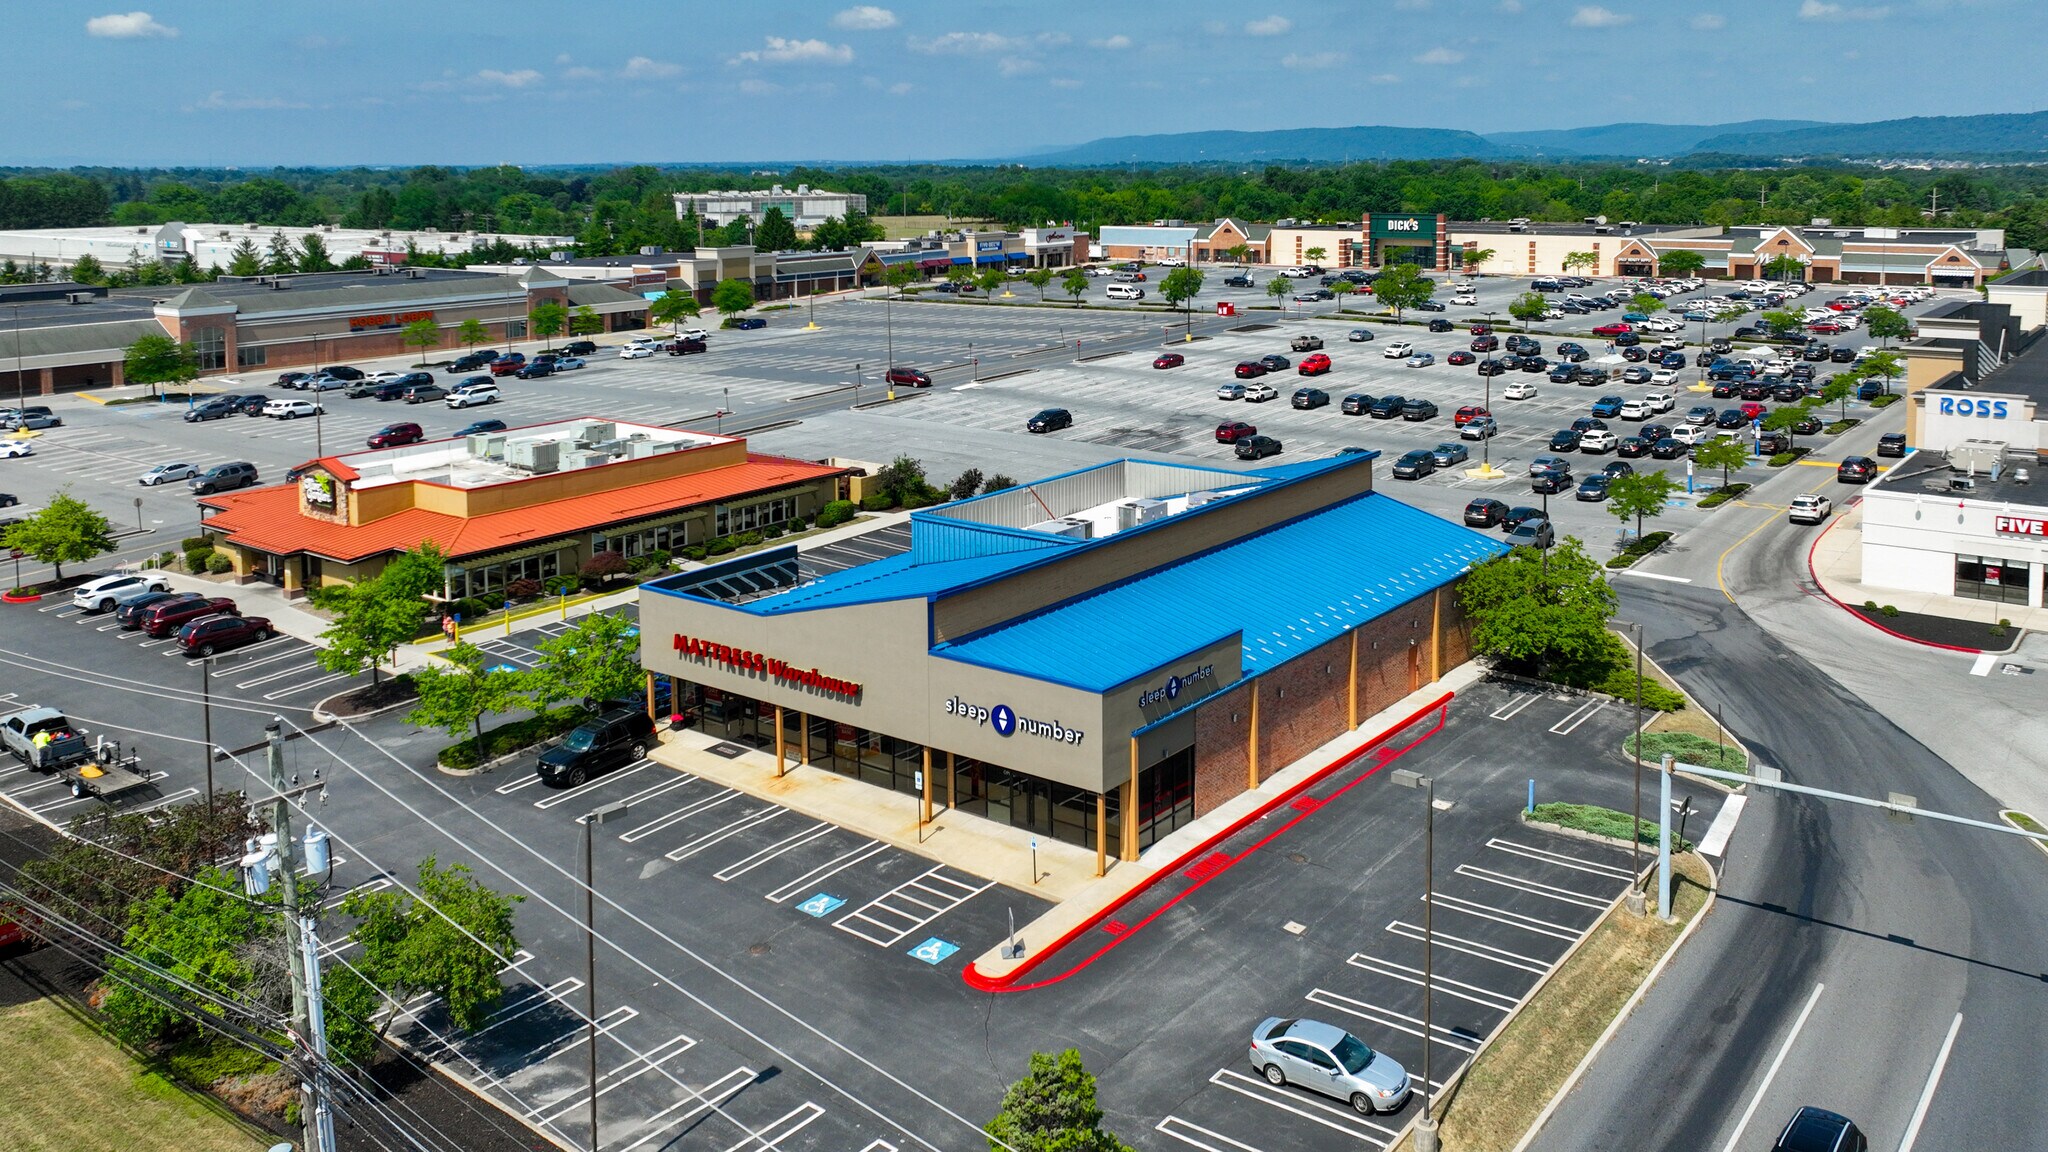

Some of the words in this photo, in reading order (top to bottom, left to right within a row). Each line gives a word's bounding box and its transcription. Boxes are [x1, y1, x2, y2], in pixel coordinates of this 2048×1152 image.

[1388, 219, 1419, 231] DICK'S
[349, 314, 391, 328] HOBBY
[1940, 397, 2008, 419] ROSS
[1996, 517, 2044, 535] FIVE
[673, 633, 766, 672] MATTRESS
[767, 657, 862, 697] Warehouse
[1139, 686, 1167, 708] sleep
[1181, 664, 1215, 689] number
[945, 696, 988, 726] sleep
[1018, 717, 1084, 746] number
